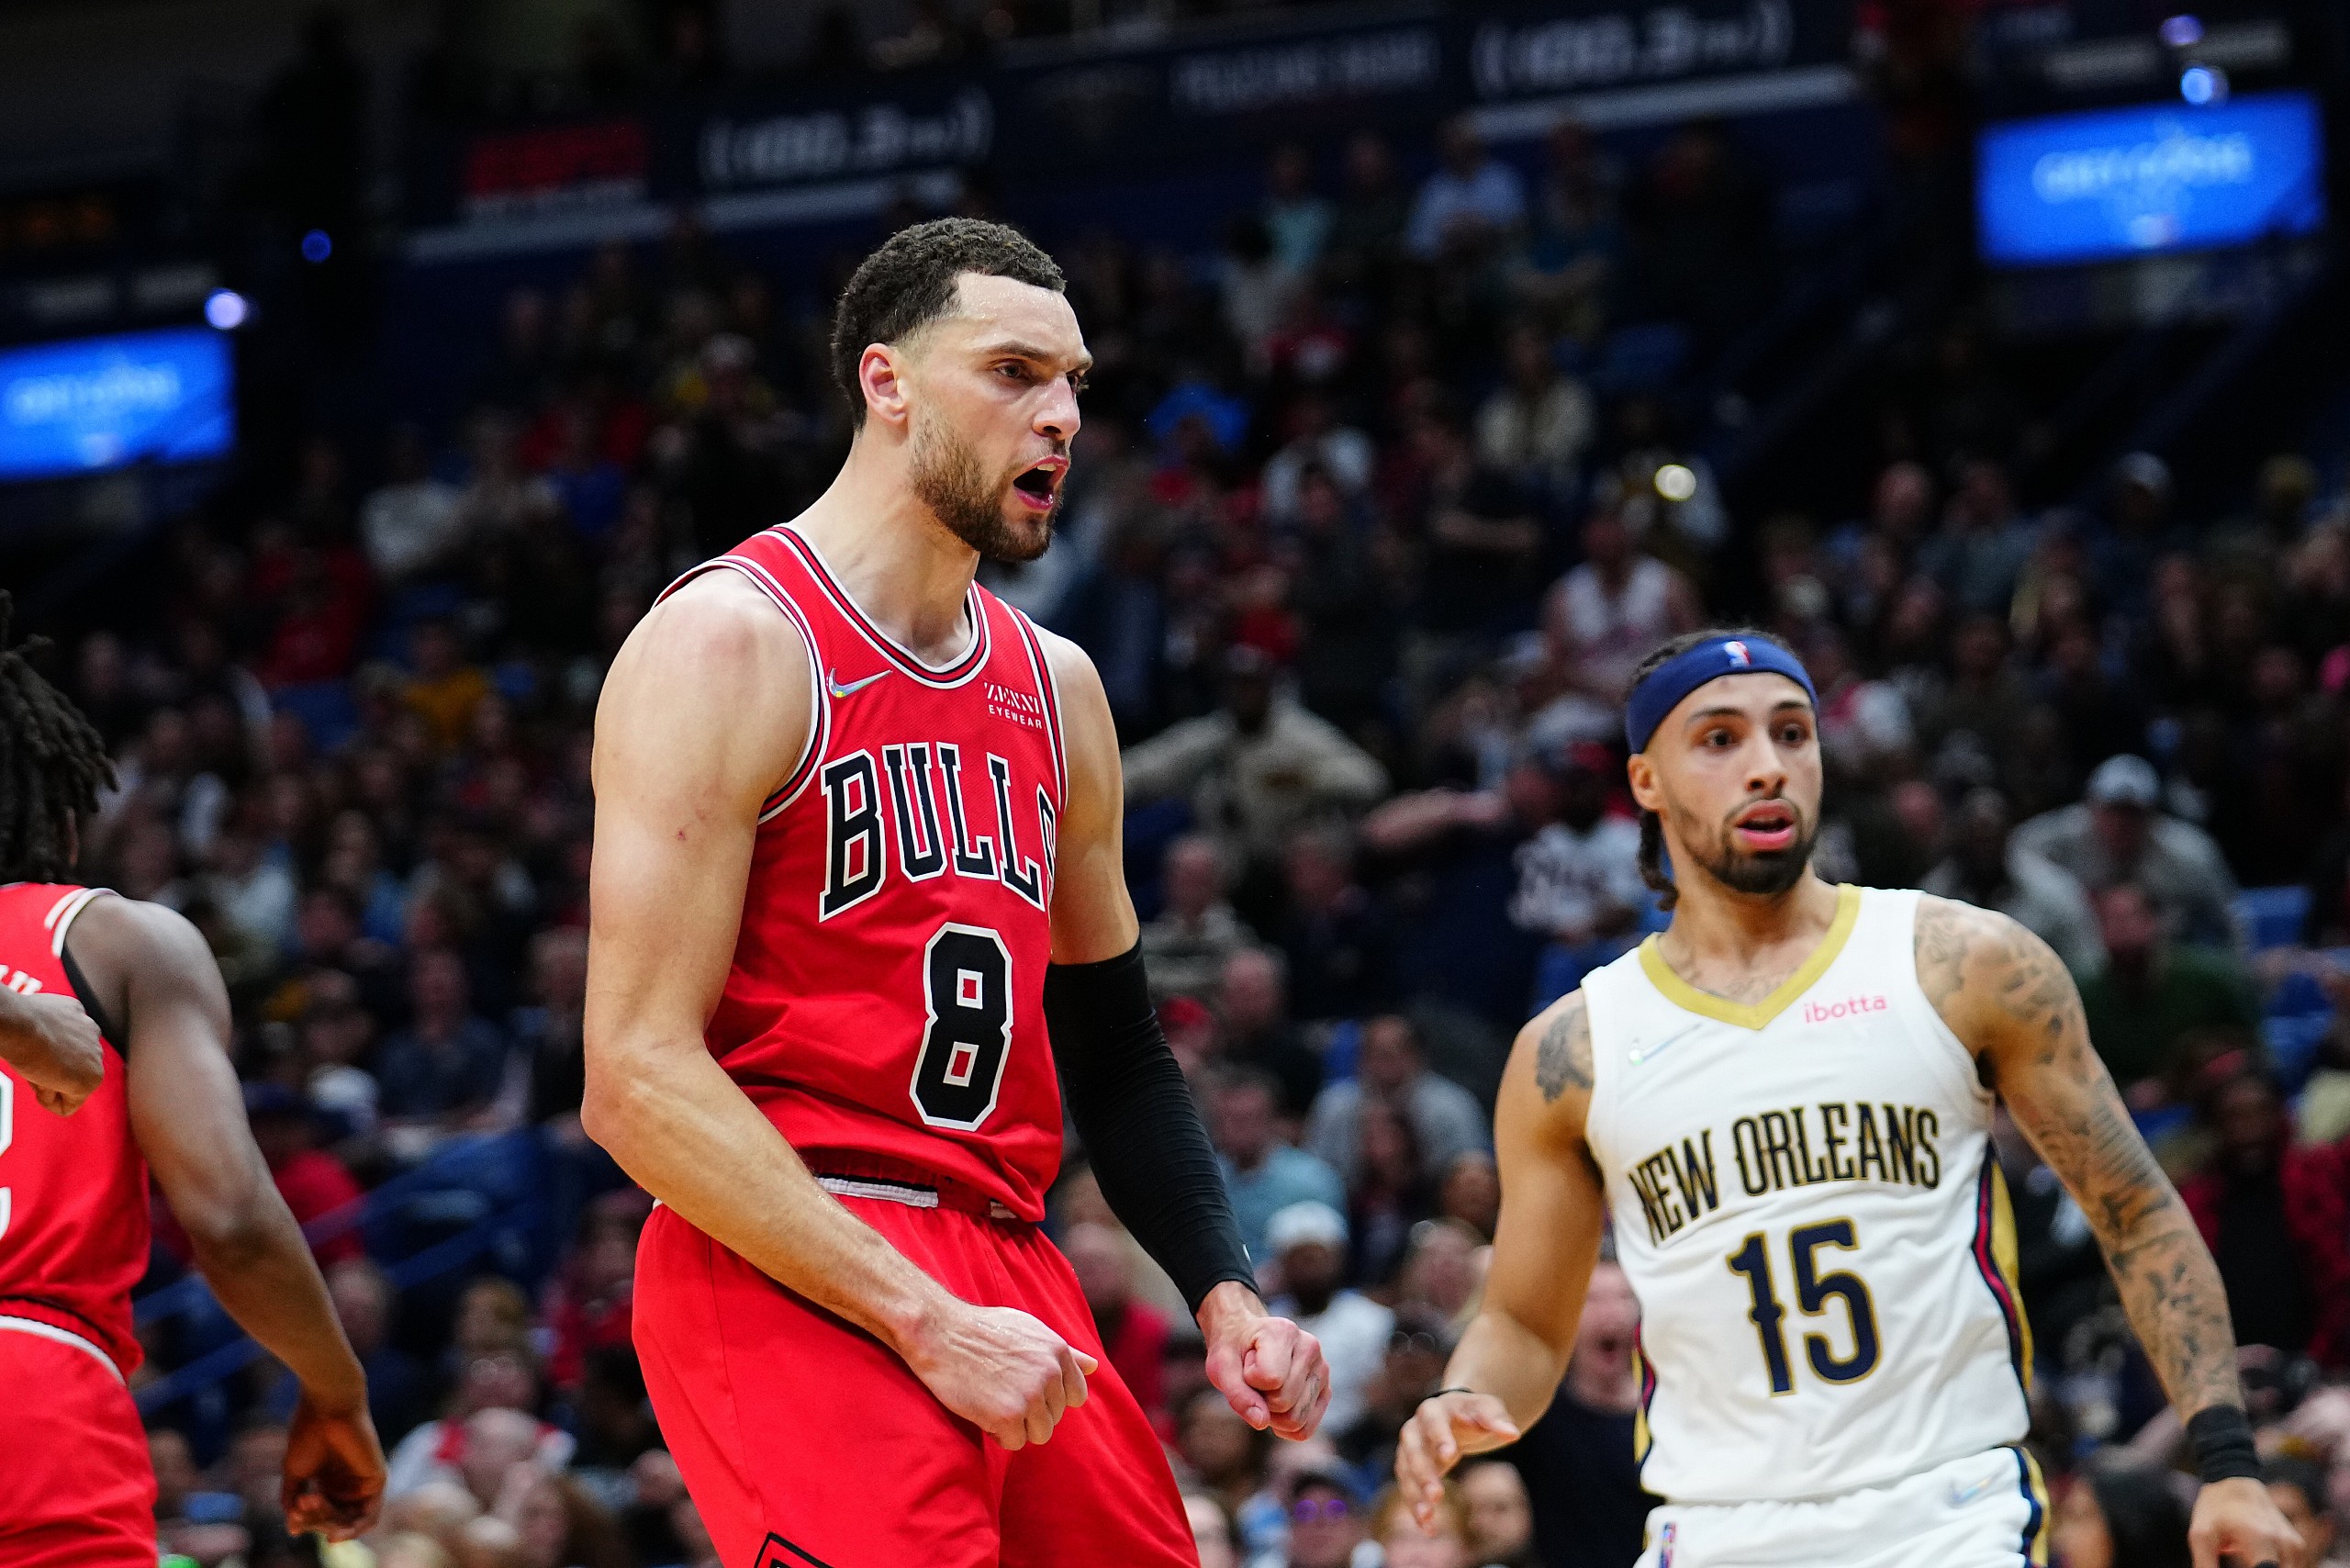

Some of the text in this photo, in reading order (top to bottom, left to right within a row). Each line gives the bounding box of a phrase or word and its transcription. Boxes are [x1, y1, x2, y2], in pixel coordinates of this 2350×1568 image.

[988, 704, 1043, 730] EYEWEAR
[909, 921, 1013, 1132] 8
[1802, 993, 1887, 1025] ibotta
[1628, 1102, 1942, 1249] NEW ORLEANS
[1726, 1215, 1884, 1398] 15
